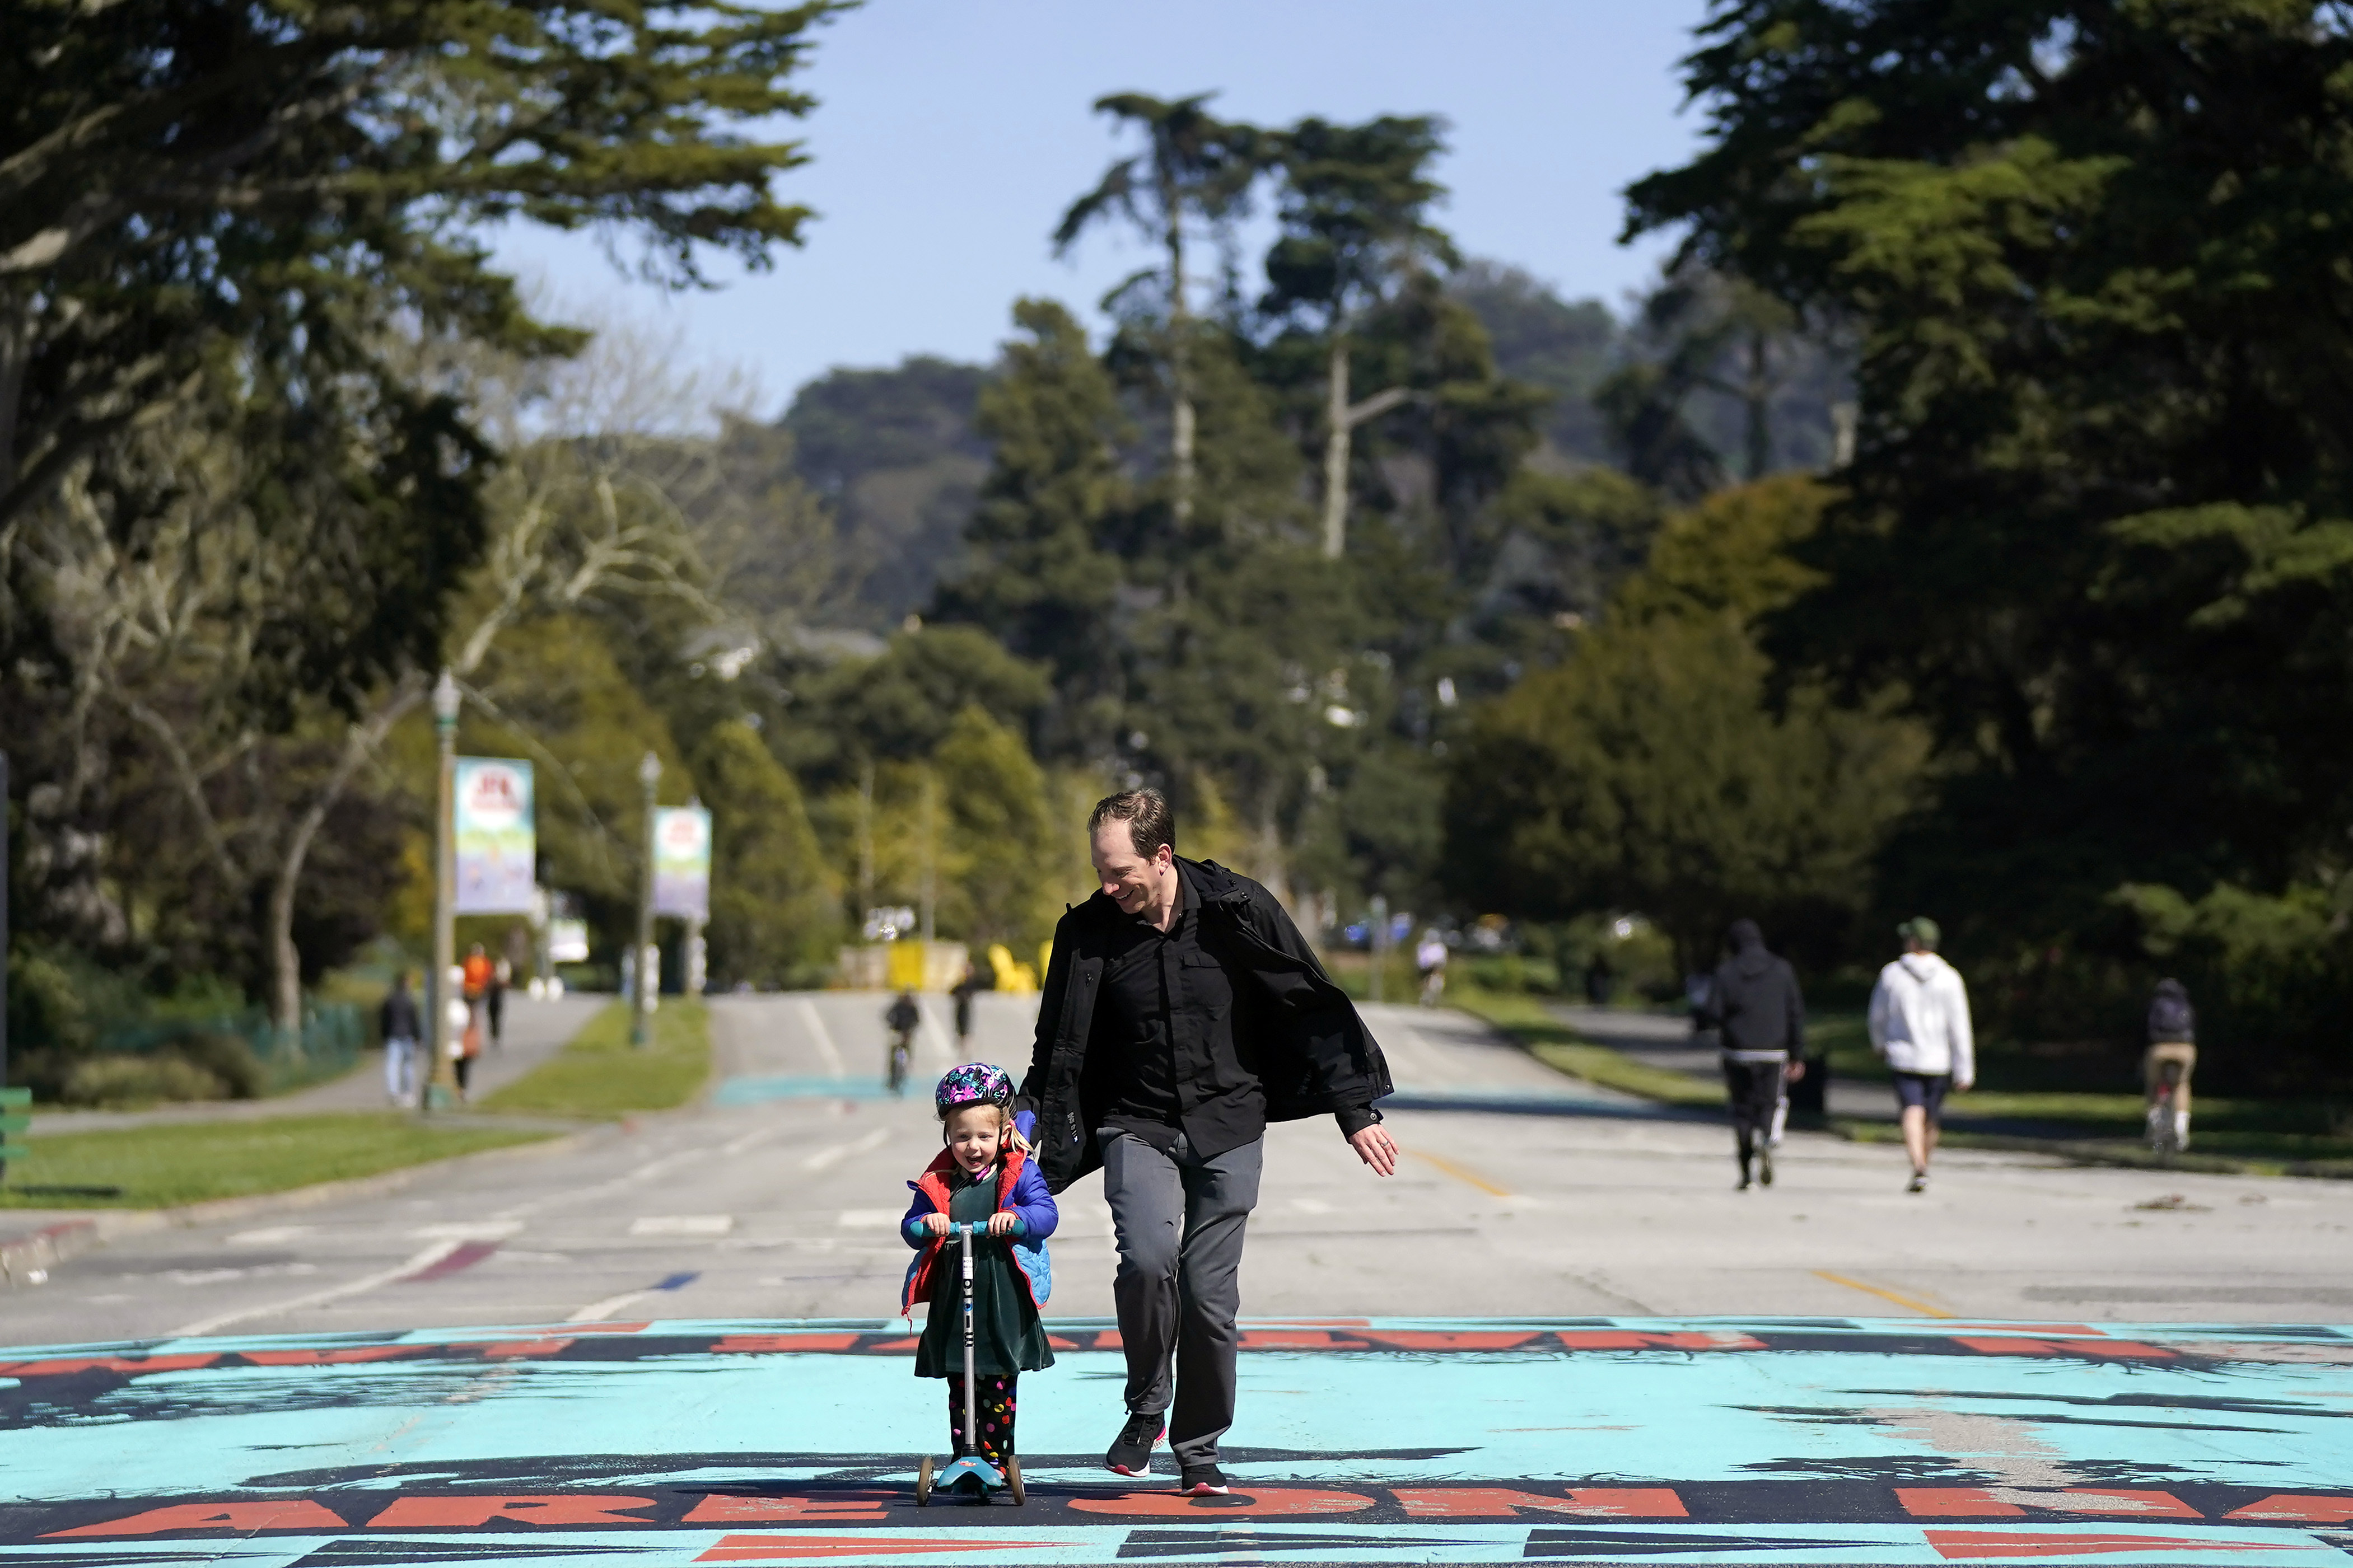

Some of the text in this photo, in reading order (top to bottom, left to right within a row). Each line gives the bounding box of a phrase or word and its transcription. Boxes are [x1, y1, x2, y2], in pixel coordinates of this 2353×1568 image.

[0, 1338, 575, 1376] LAN
[34, 1491, 898, 1538] ARE
[1067, 1487, 1689, 1518] ON
